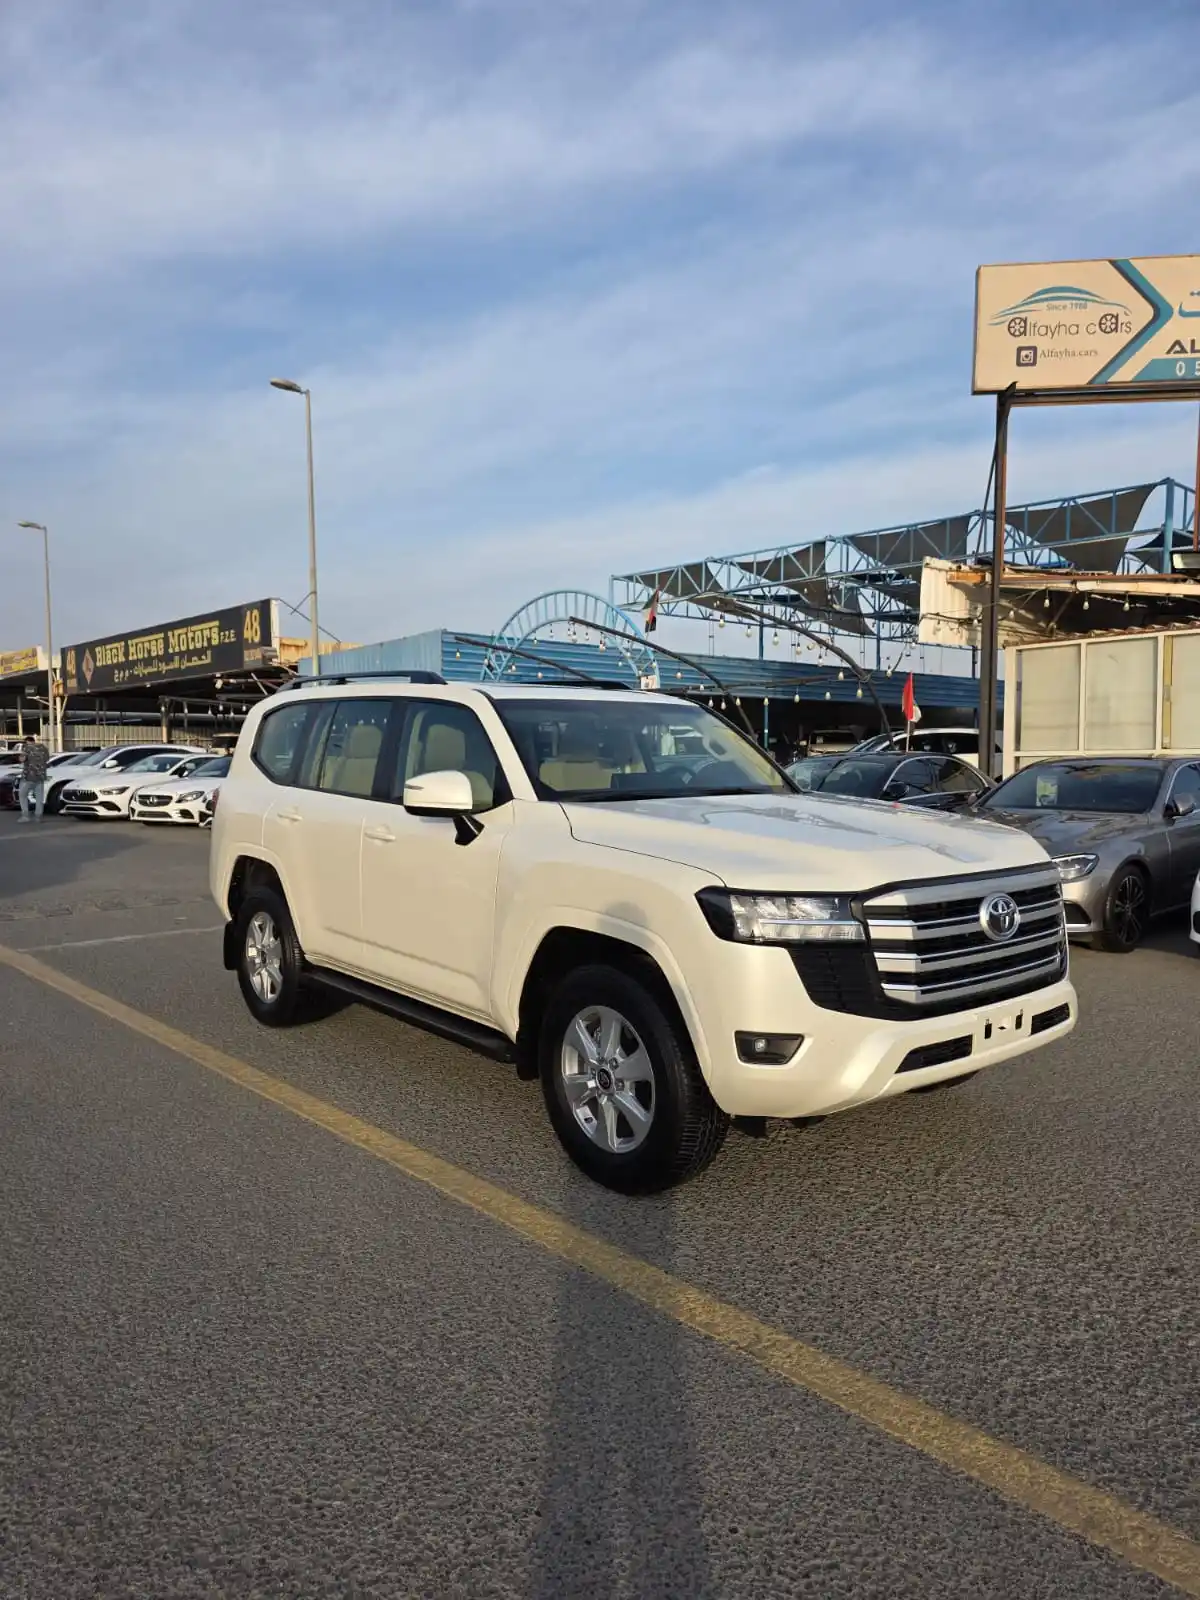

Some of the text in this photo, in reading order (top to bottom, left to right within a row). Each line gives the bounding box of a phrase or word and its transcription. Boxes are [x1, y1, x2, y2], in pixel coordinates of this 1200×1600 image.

[1046, 303, 1068, 312] Since
[1008, 312, 1133, 340] alfayha cars
[1039, 348, 1098, 359] Alfayha.cars
[244, 609, 260, 643] 48
[95, 641, 125, 667] Black
[128, 633, 164, 660] Horse
[168, 620, 220, 653] Motors
